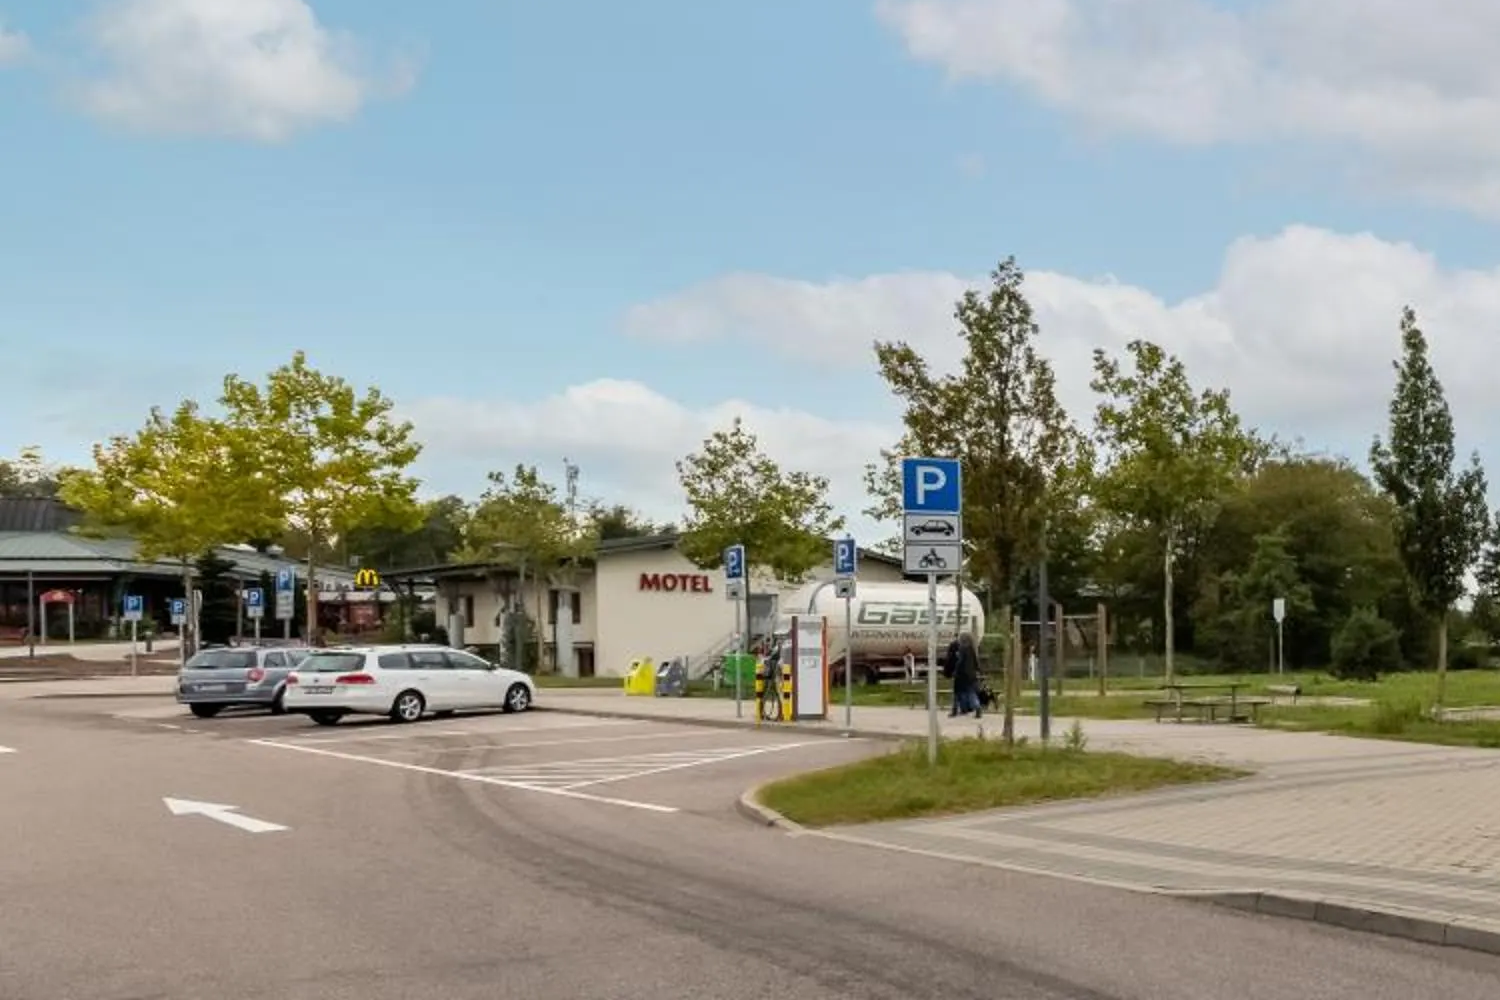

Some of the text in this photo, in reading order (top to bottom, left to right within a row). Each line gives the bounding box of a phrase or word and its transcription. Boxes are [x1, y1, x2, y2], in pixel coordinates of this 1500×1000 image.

[916, 465, 947, 505] P
[727, 551, 737, 577] P
[838, 543, 849, 570] P
[280, 571, 289, 588] P
[640, 573, 713, 593] MOTEL
[173, 601, 183, 612] P
[250, 591, 259, 604] P
